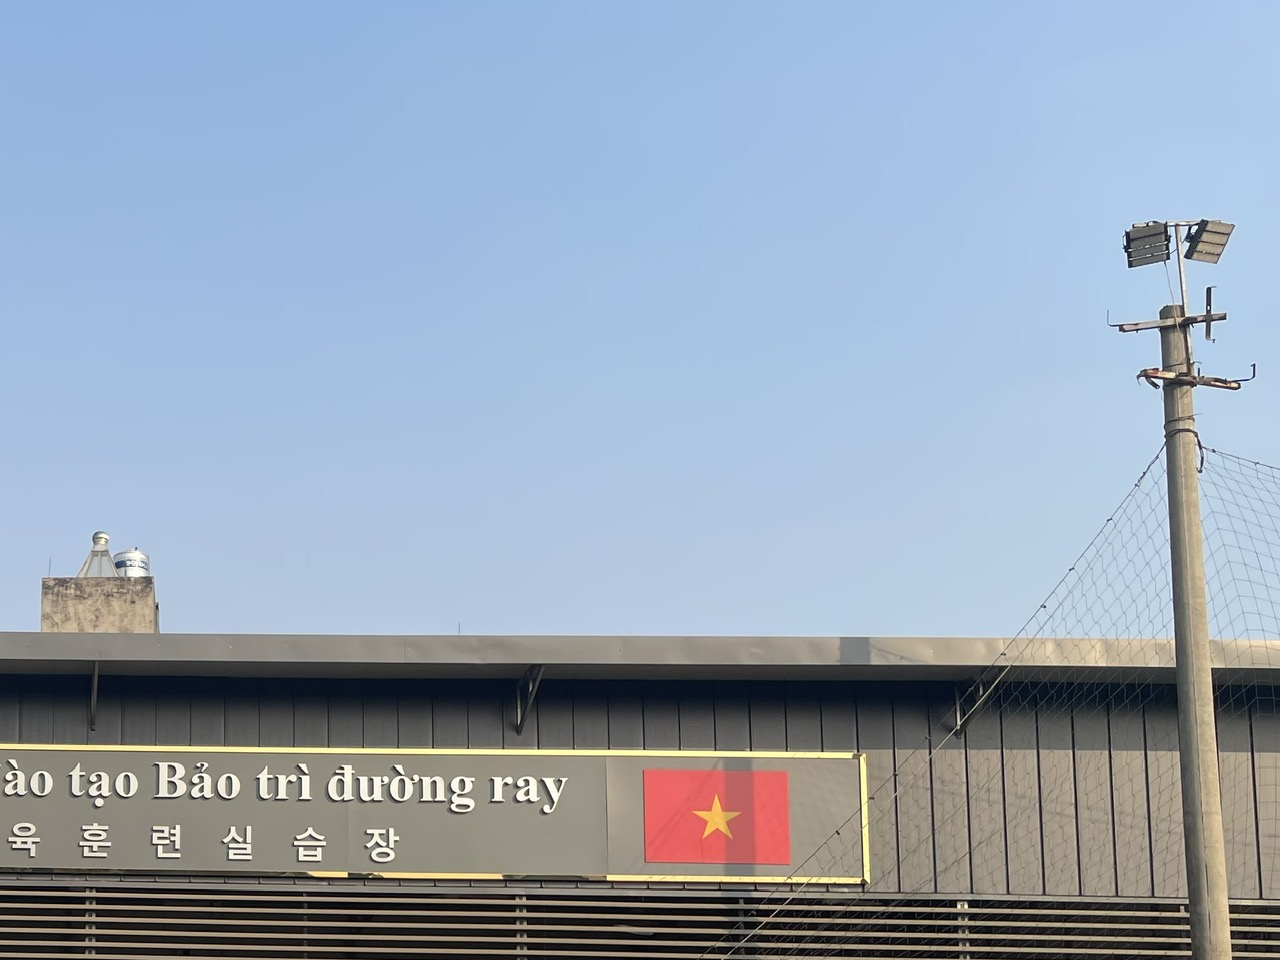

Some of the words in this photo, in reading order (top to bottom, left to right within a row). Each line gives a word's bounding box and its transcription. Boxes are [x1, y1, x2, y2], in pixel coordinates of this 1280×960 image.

[68, 762, 139, 807] tạo
[153, 761, 241, 799] Bảo
[255, 763, 314, 801] trì
[327, 764, 476, 813] đường
[488, 773, 569, 814] ray
